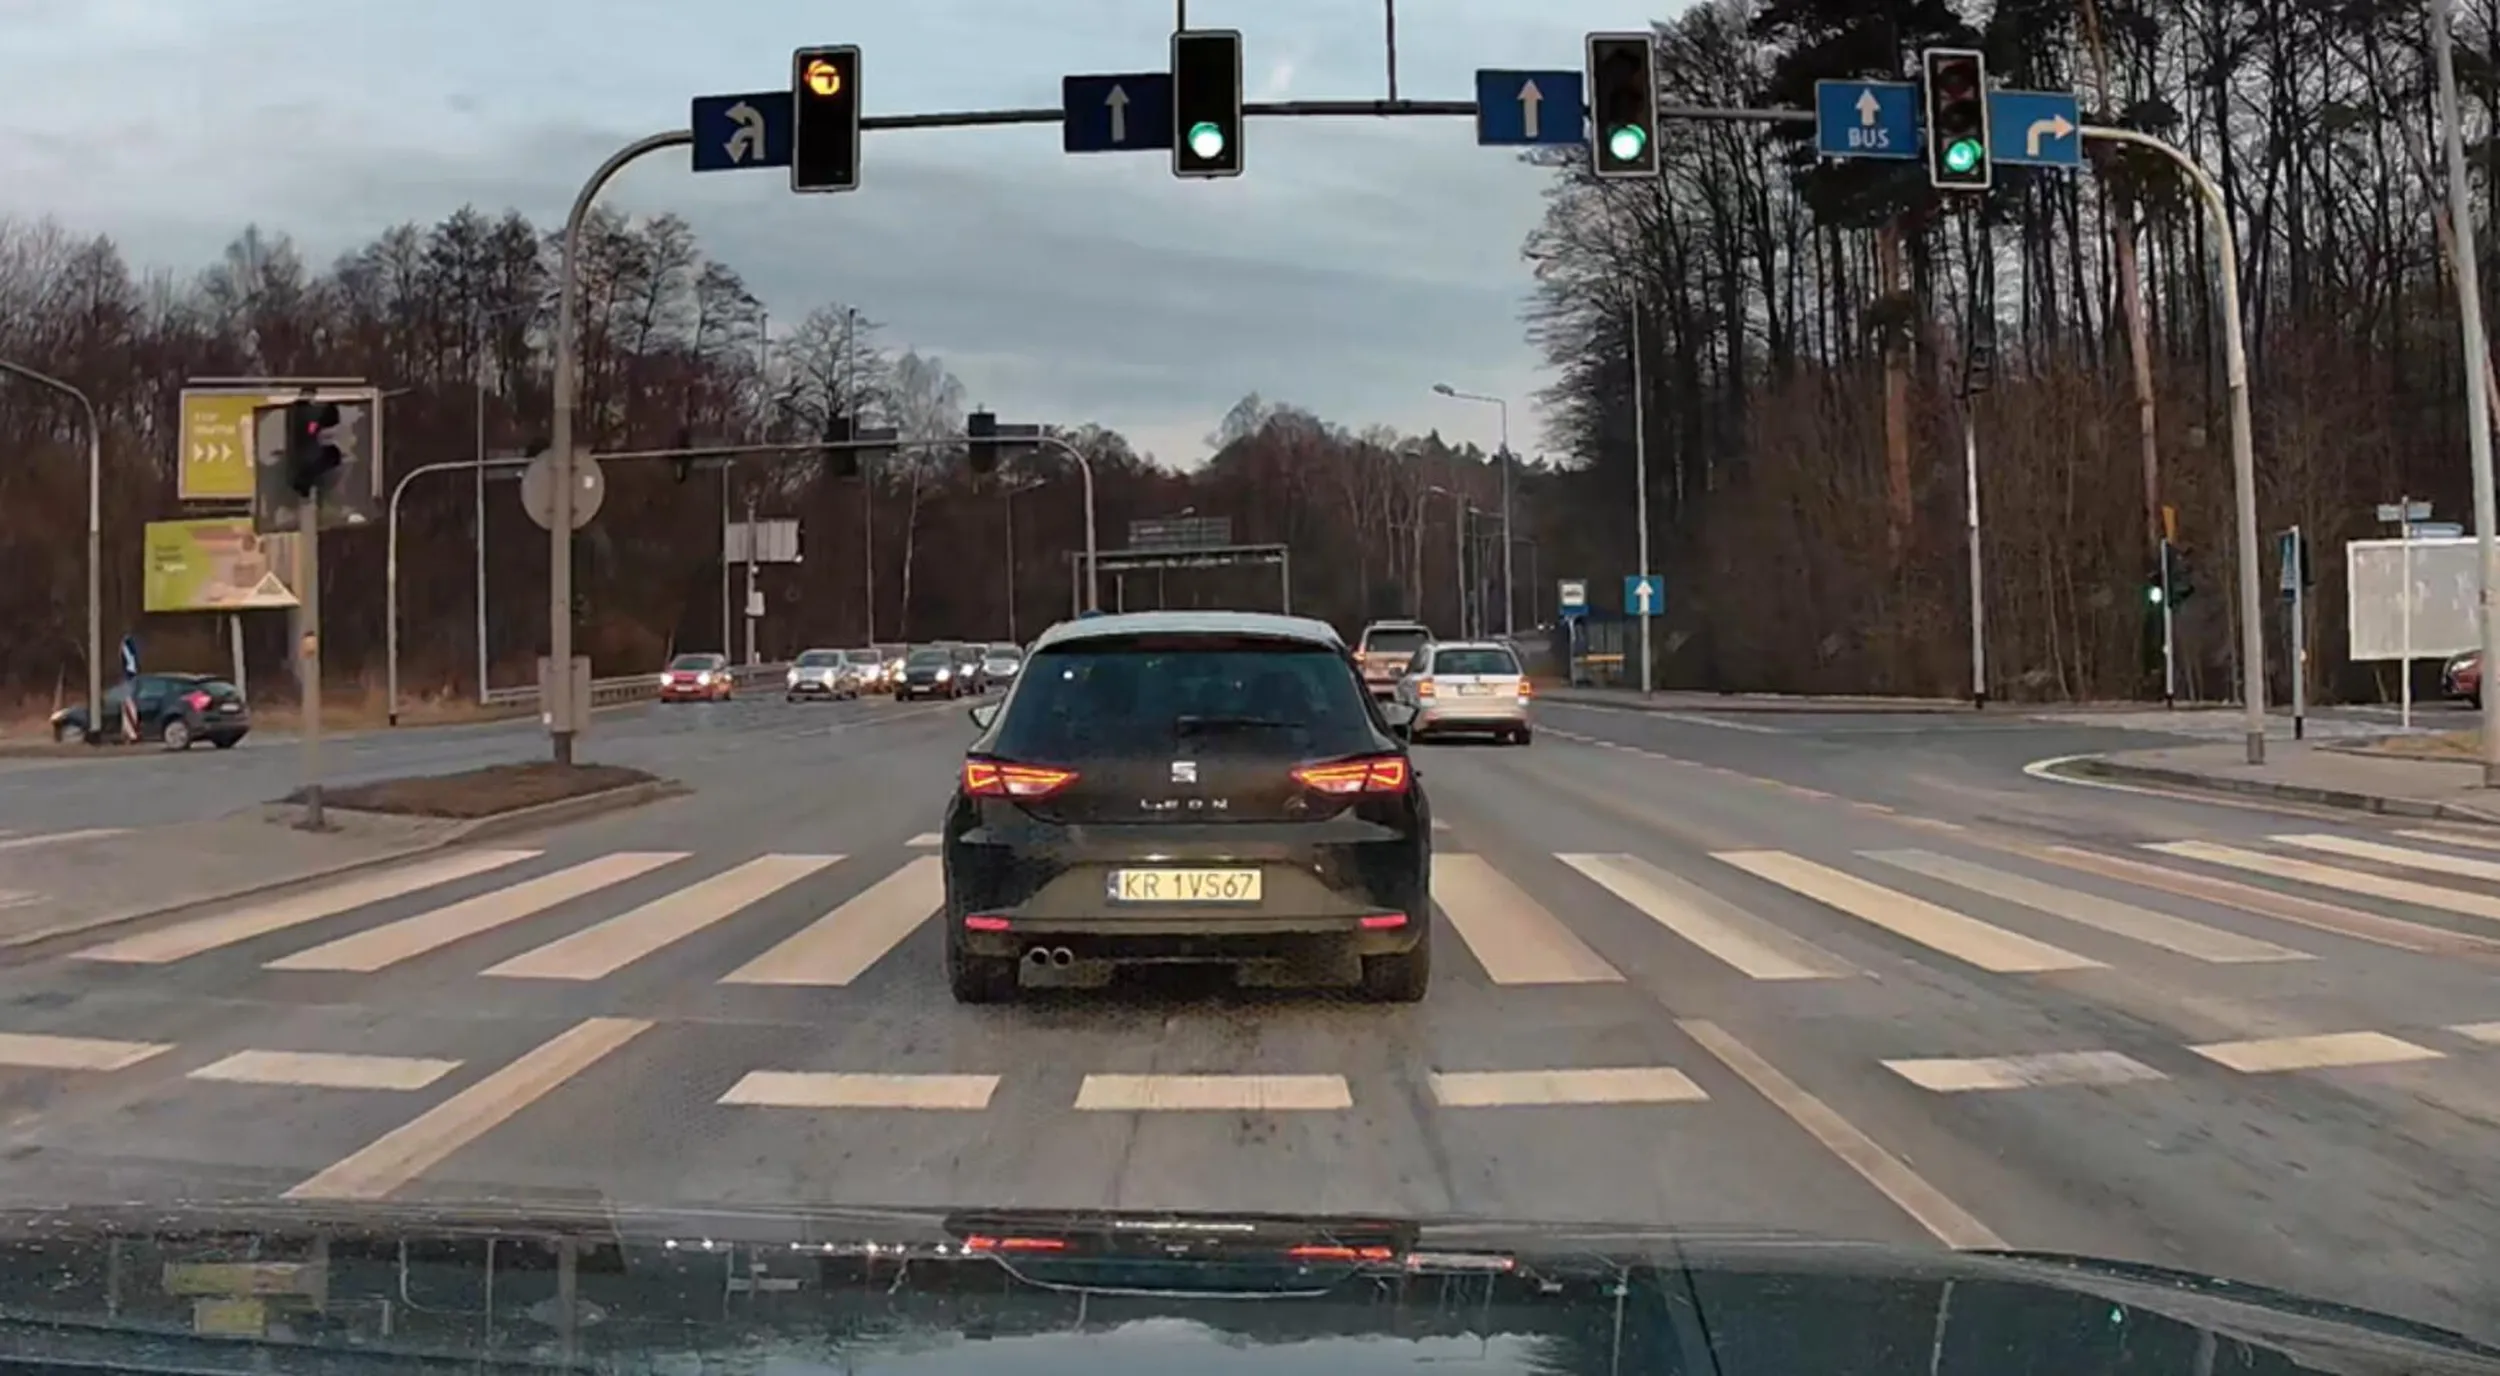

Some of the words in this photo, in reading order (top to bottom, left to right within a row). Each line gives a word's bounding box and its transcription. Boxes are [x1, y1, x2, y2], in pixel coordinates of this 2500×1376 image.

[1848, 127, 1889, 148] BUS
[1140, 798, 1228, 810] LEON
[1125, 873, 1160, 899] KR
[1174, 873, 1254, 899] 1VS67
